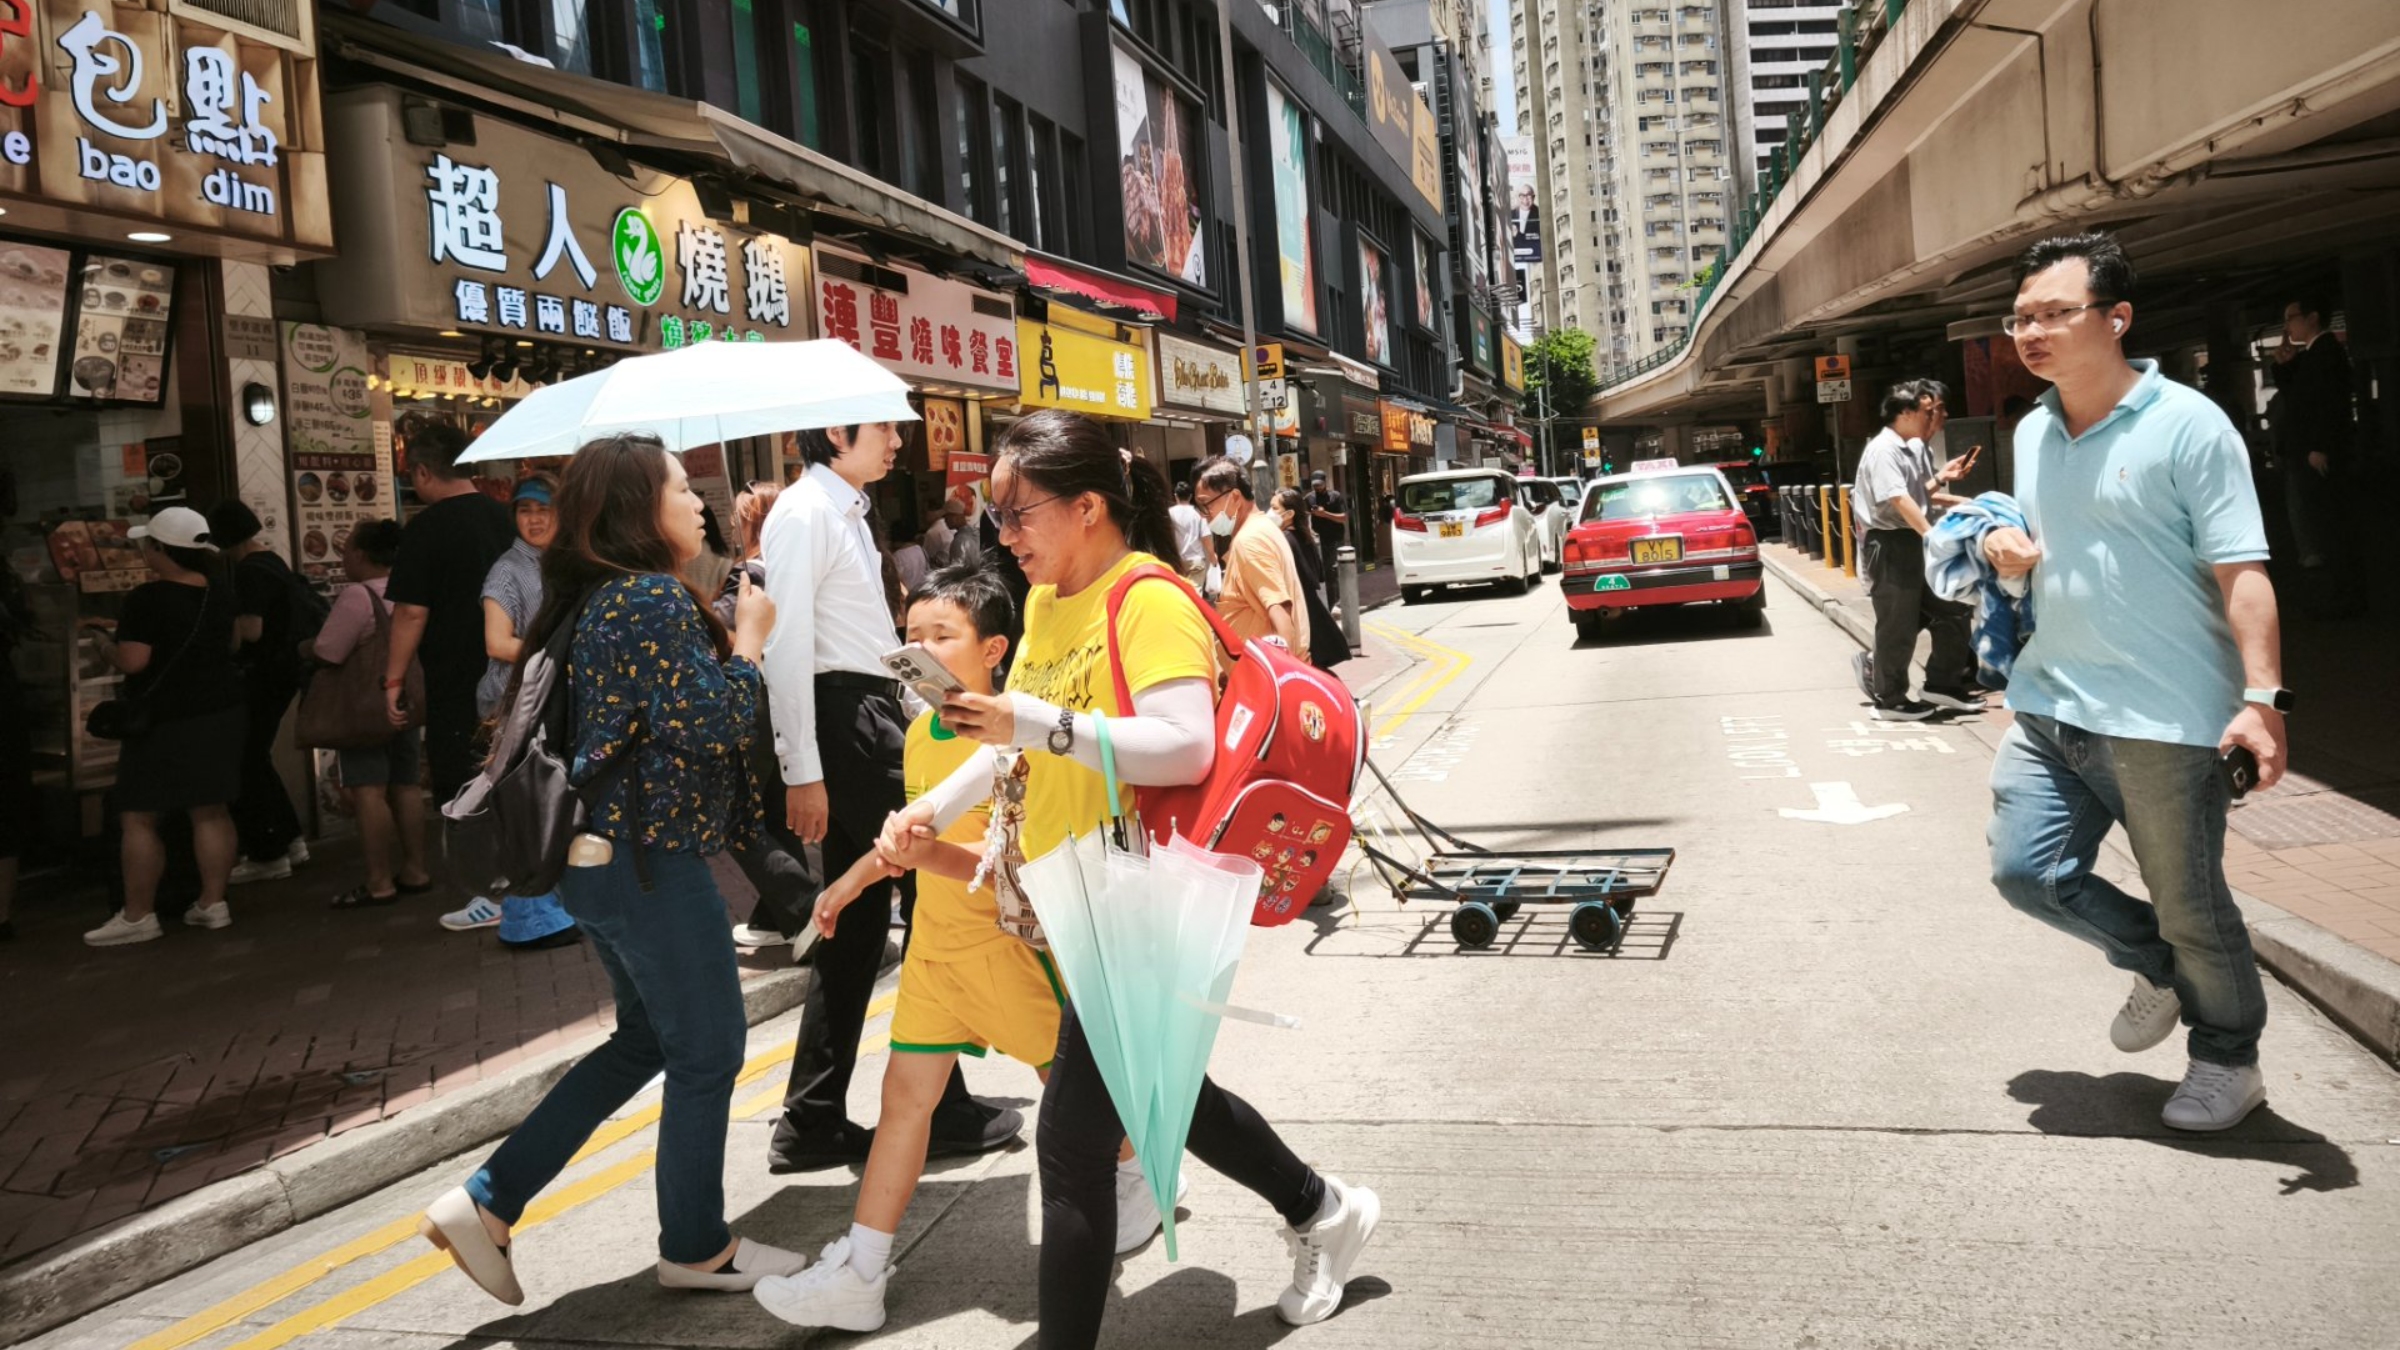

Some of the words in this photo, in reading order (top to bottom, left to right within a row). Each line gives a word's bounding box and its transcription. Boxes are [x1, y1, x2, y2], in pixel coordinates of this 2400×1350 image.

[57, 9, 279, 168] 包點
[79, 138, 161, 192] bao
[202, 168, 276, 215] dim
[427, 152, 599, 292] 超人
[676, 218, 793, 329] 燒鵝
[1269, 380, 1277, 390] 4
[1271, 396, 1285, 407] 12
[1636, 459, 1675, 471] TAXI
[1647, 540, 1665, 551] VY
[1641, 549, 1675, 562] 8015
[1608, 577, 1616, 585] 4
